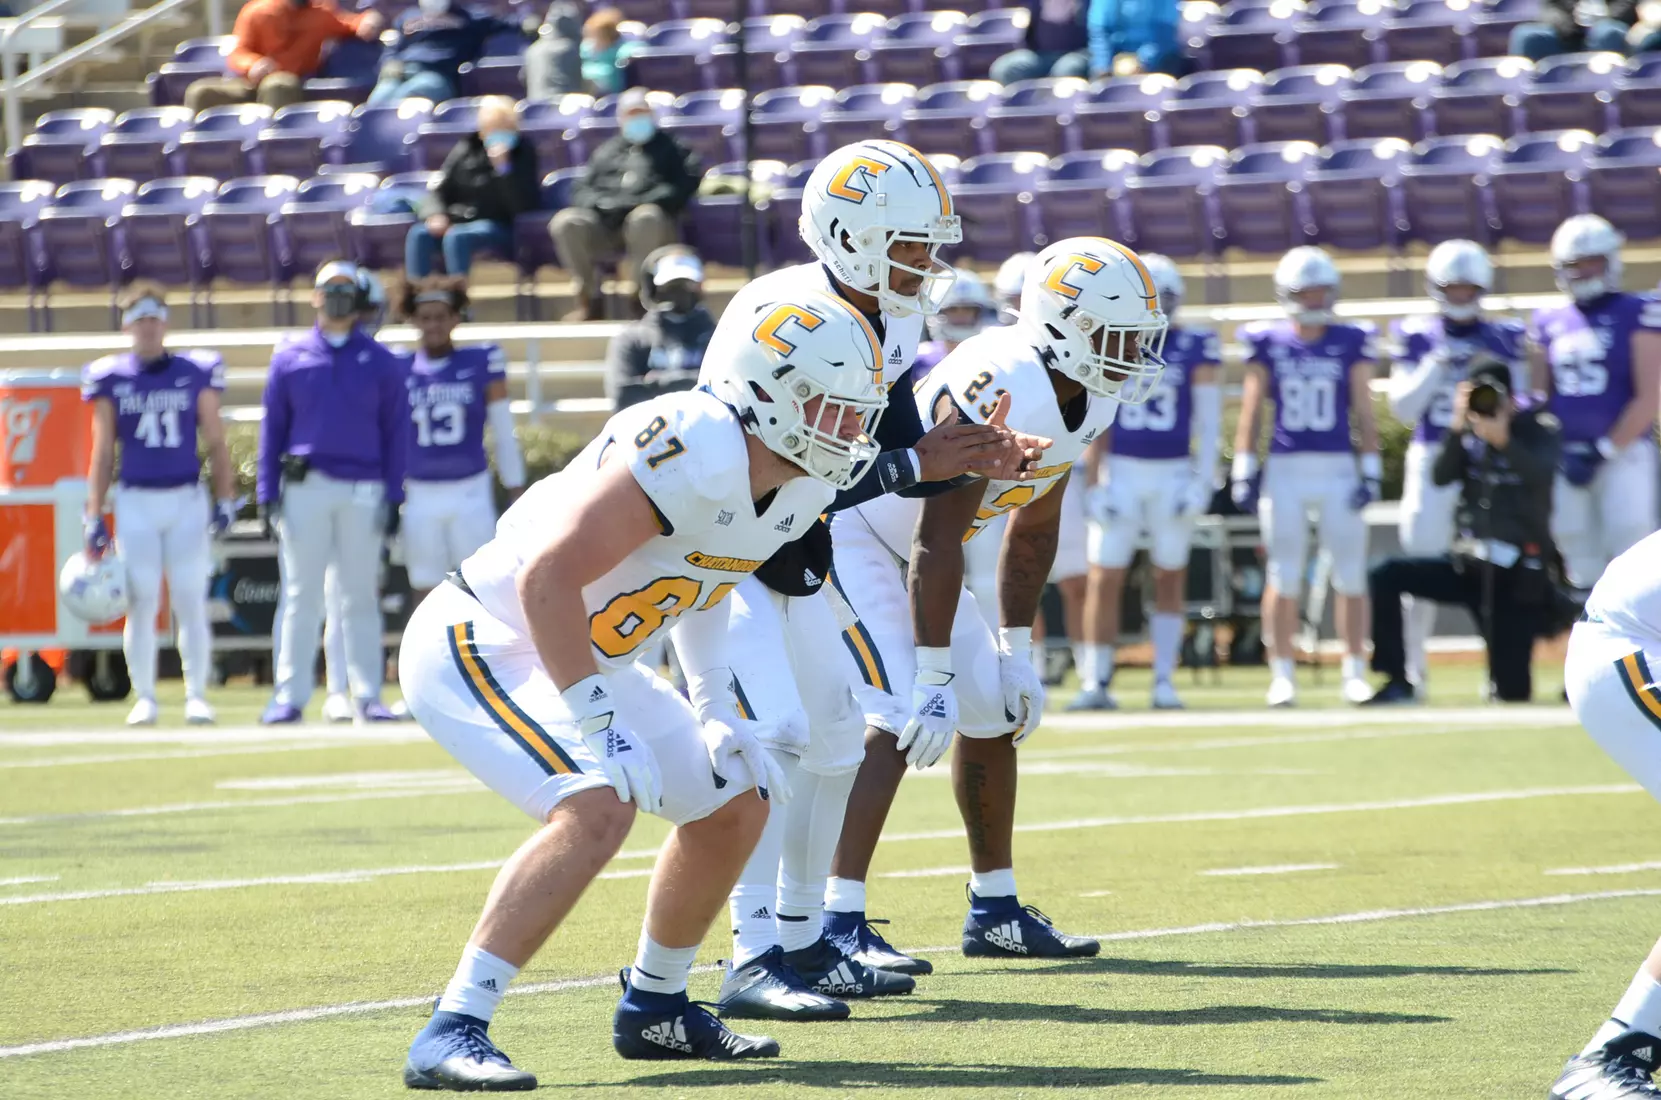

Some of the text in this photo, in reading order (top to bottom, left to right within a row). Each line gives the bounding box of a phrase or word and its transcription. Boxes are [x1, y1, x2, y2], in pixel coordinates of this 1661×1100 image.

[833, 260, 852, 283] schutt
[752, 303, 826, 359] C
[1280, 377, 1337, 432] 80
[134, 409, 183, 448] 41
[411, 402, 466, 447] 13
[634, 416, 688, 471] 87
[919, 693, 942, 716] adidas
[607, 728, 617, 758] adidas
[984, 931, 1028, 954] adidas
[811, 983, 863, 994] adidas
[641, 1029, 692, 1053] adidas
